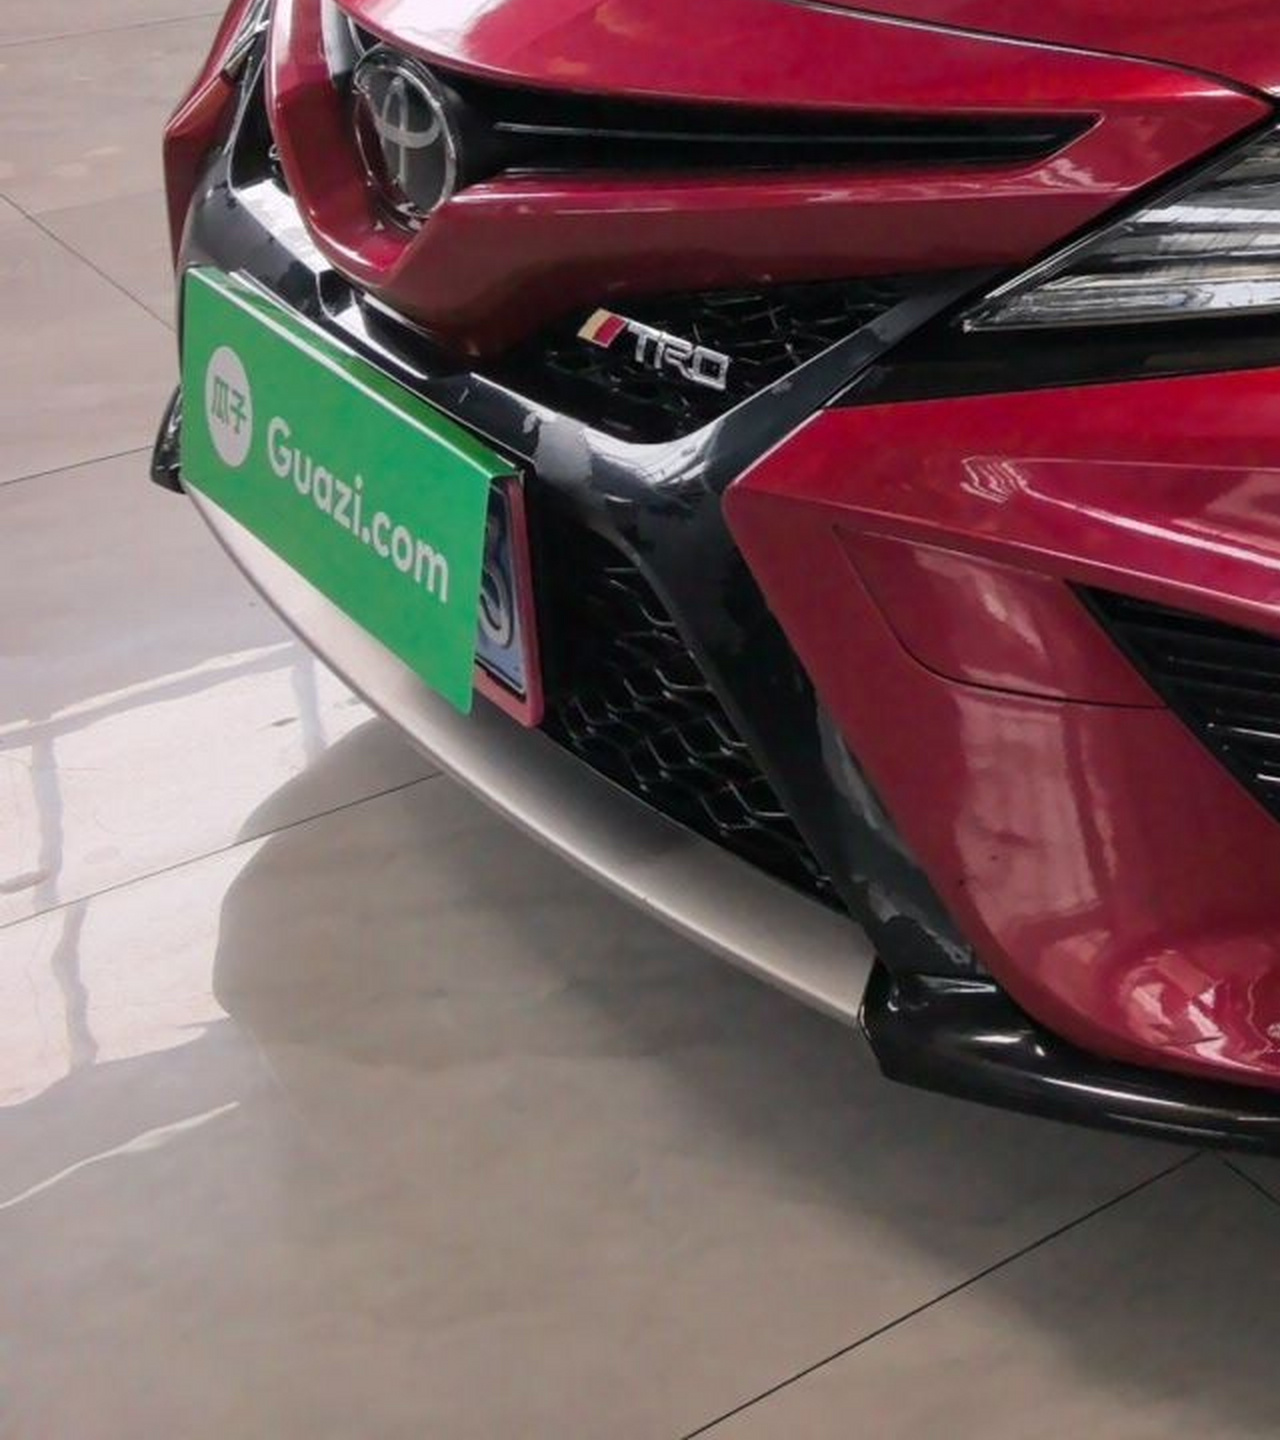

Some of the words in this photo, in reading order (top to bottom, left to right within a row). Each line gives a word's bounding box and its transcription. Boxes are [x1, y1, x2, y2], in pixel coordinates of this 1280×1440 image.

[627, 320, 731, 390] TRD
[211, 375, 248, 435] 瓜子
[267, 416, 449, 603] Guazi.com
